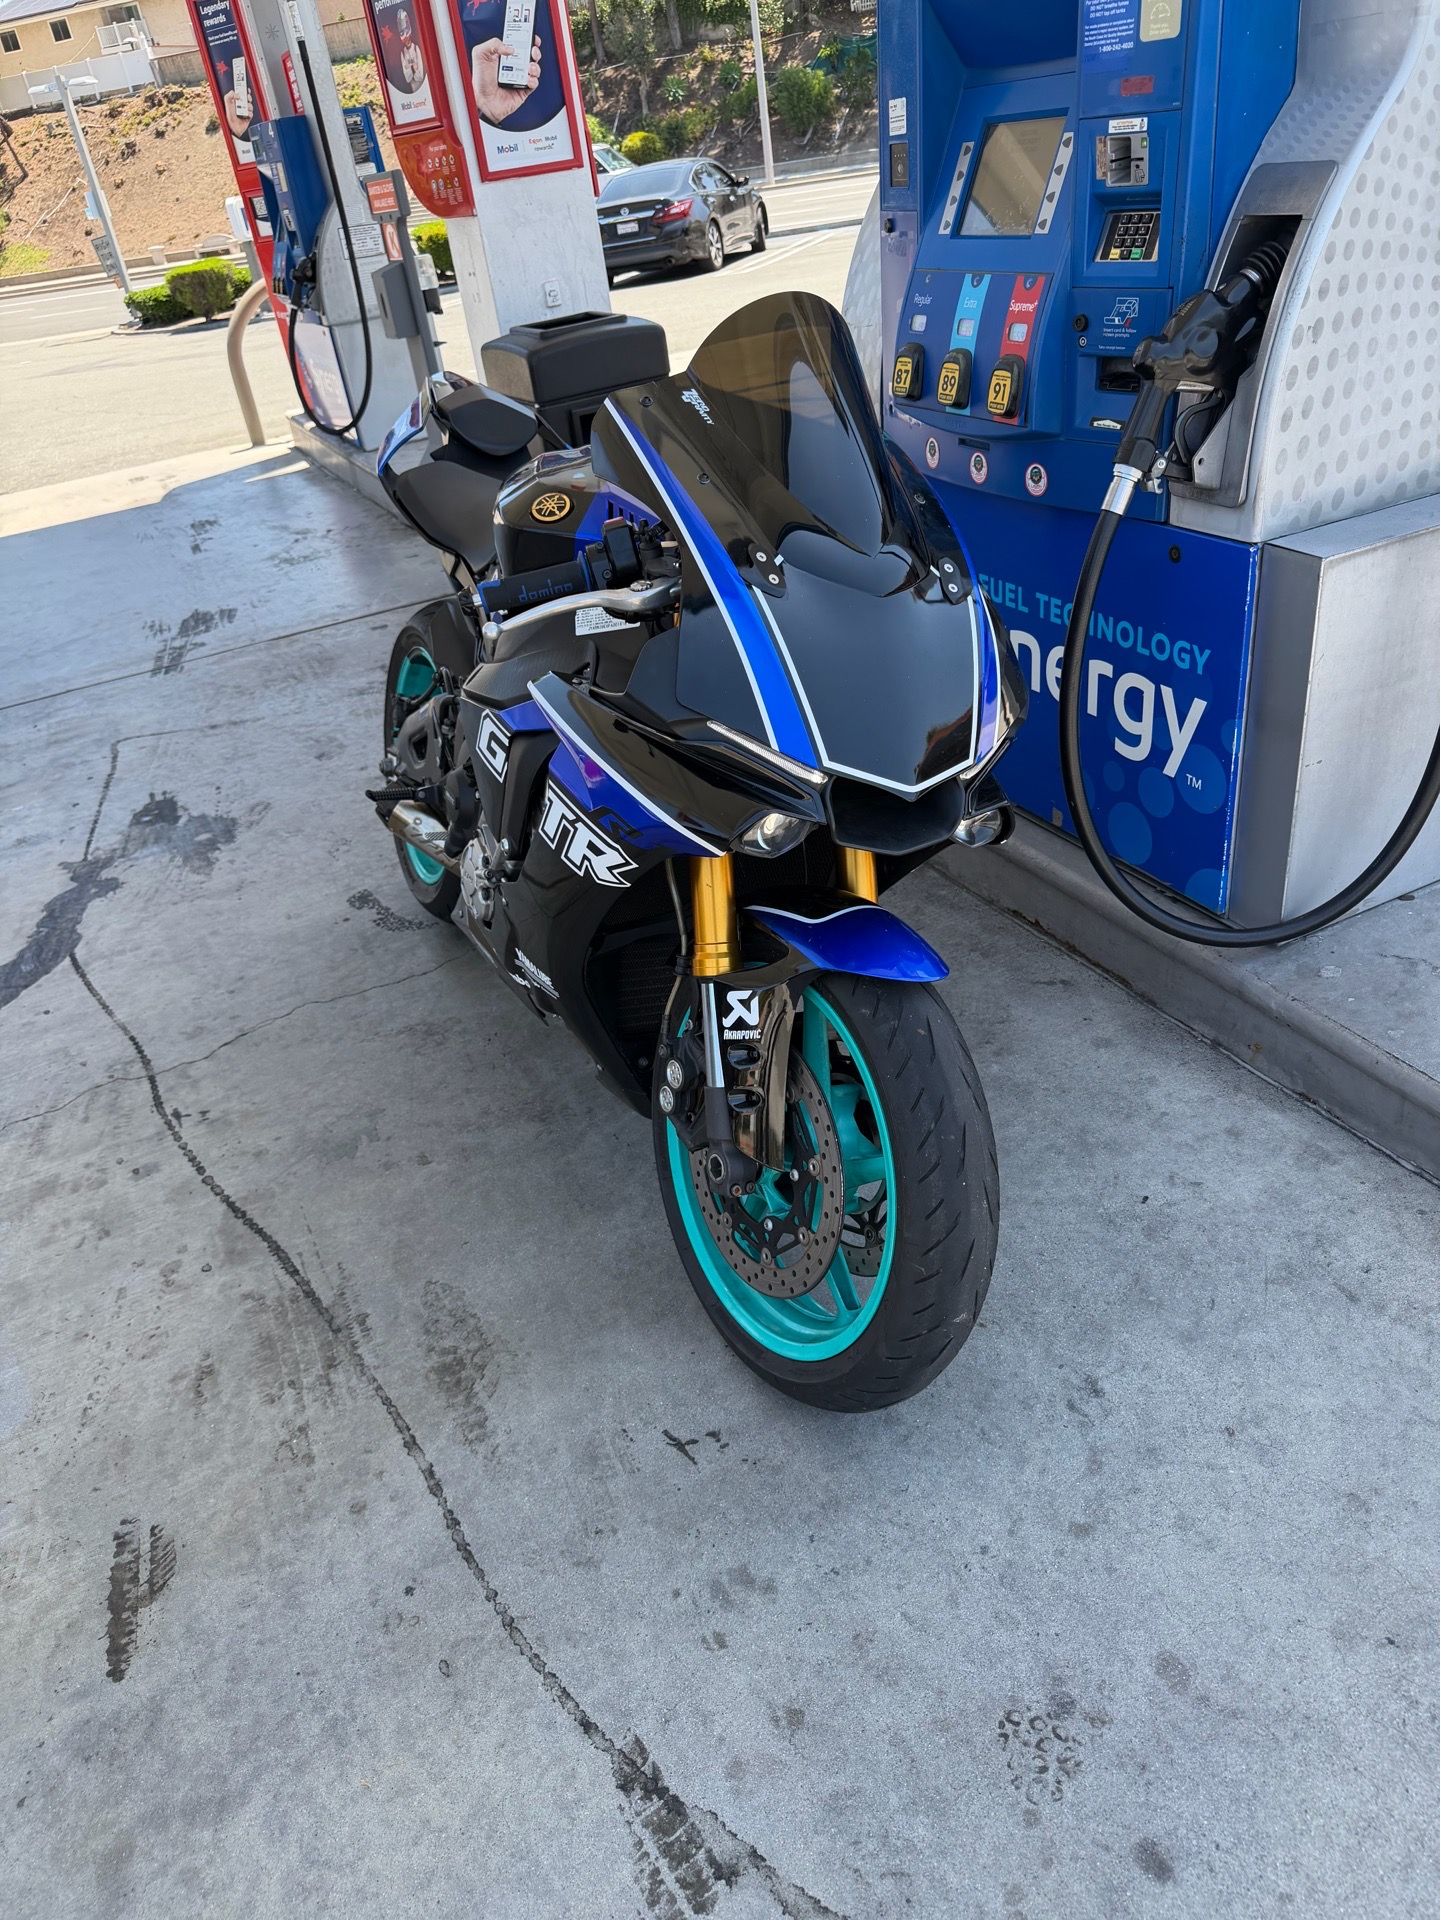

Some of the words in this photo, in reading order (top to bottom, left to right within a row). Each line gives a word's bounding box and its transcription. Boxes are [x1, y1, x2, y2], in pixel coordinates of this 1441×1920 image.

[200, 0, 229, 15] Legendary
[204, 13, 226, 27] rewards
[497, 143, 519, 154] Mobil
[914, 293, 932, 307] Regular
[964, 297, 977, 308] Extra
[896, 369, 910, 385] 87
[942, 374, 956, 393] 89
[994, 382, 1006, 402] 91
[519, 579, 572, 601] domino
[979, 573, 1028, 613] FUEL
[1009, 630, 1207, 778] nergy
[1186, 773, 1201, 790] TM
